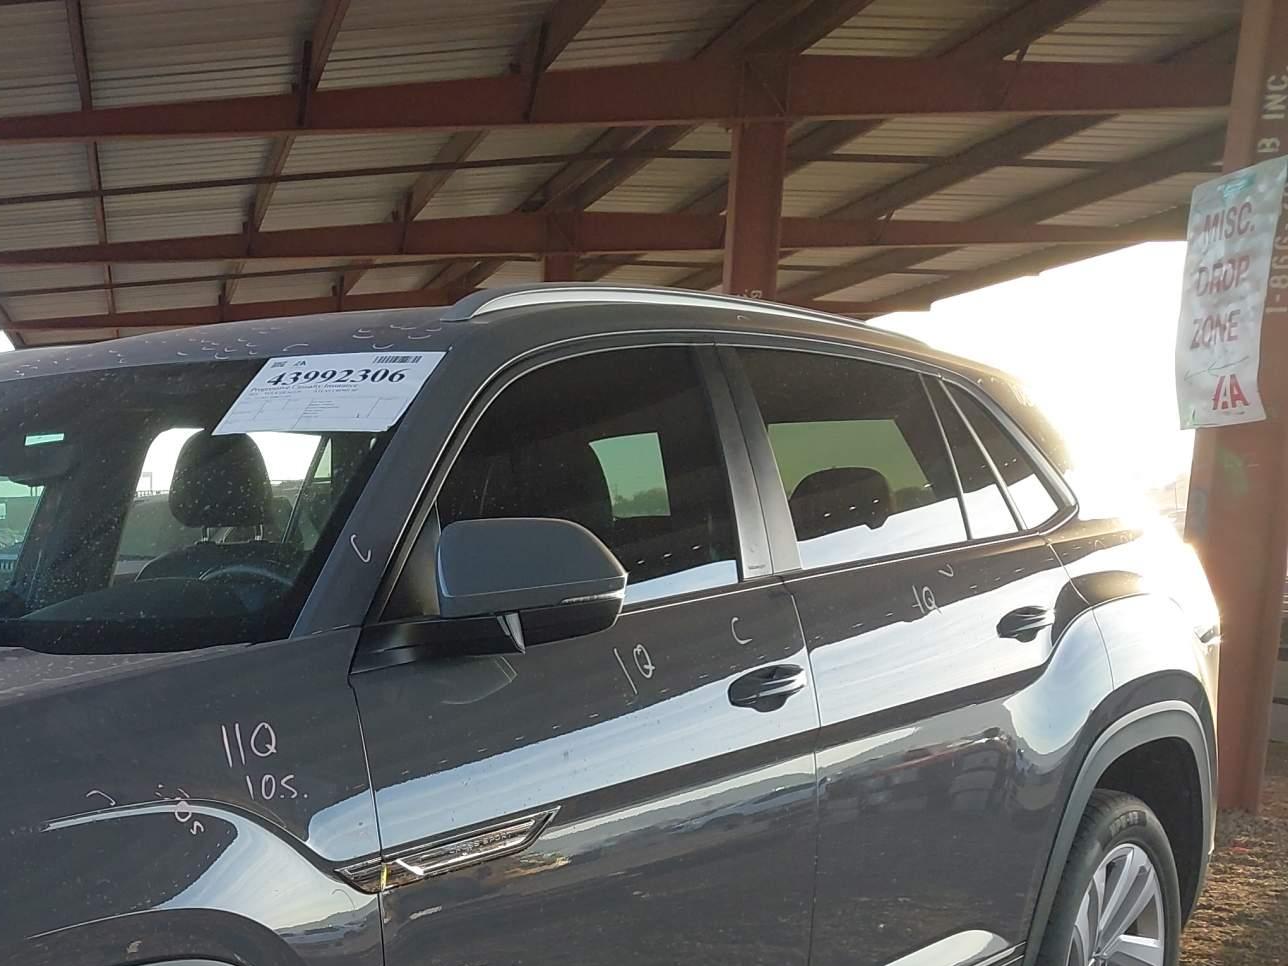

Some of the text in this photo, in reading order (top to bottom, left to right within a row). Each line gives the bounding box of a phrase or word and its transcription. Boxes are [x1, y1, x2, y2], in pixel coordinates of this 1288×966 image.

[1203, 201, 1256, 245] MISC.
[1195, 255, 1250, 298] DROP
[1190, 309, 1241, 350] ZONE
[267, 368, 409, 386] 43992306
